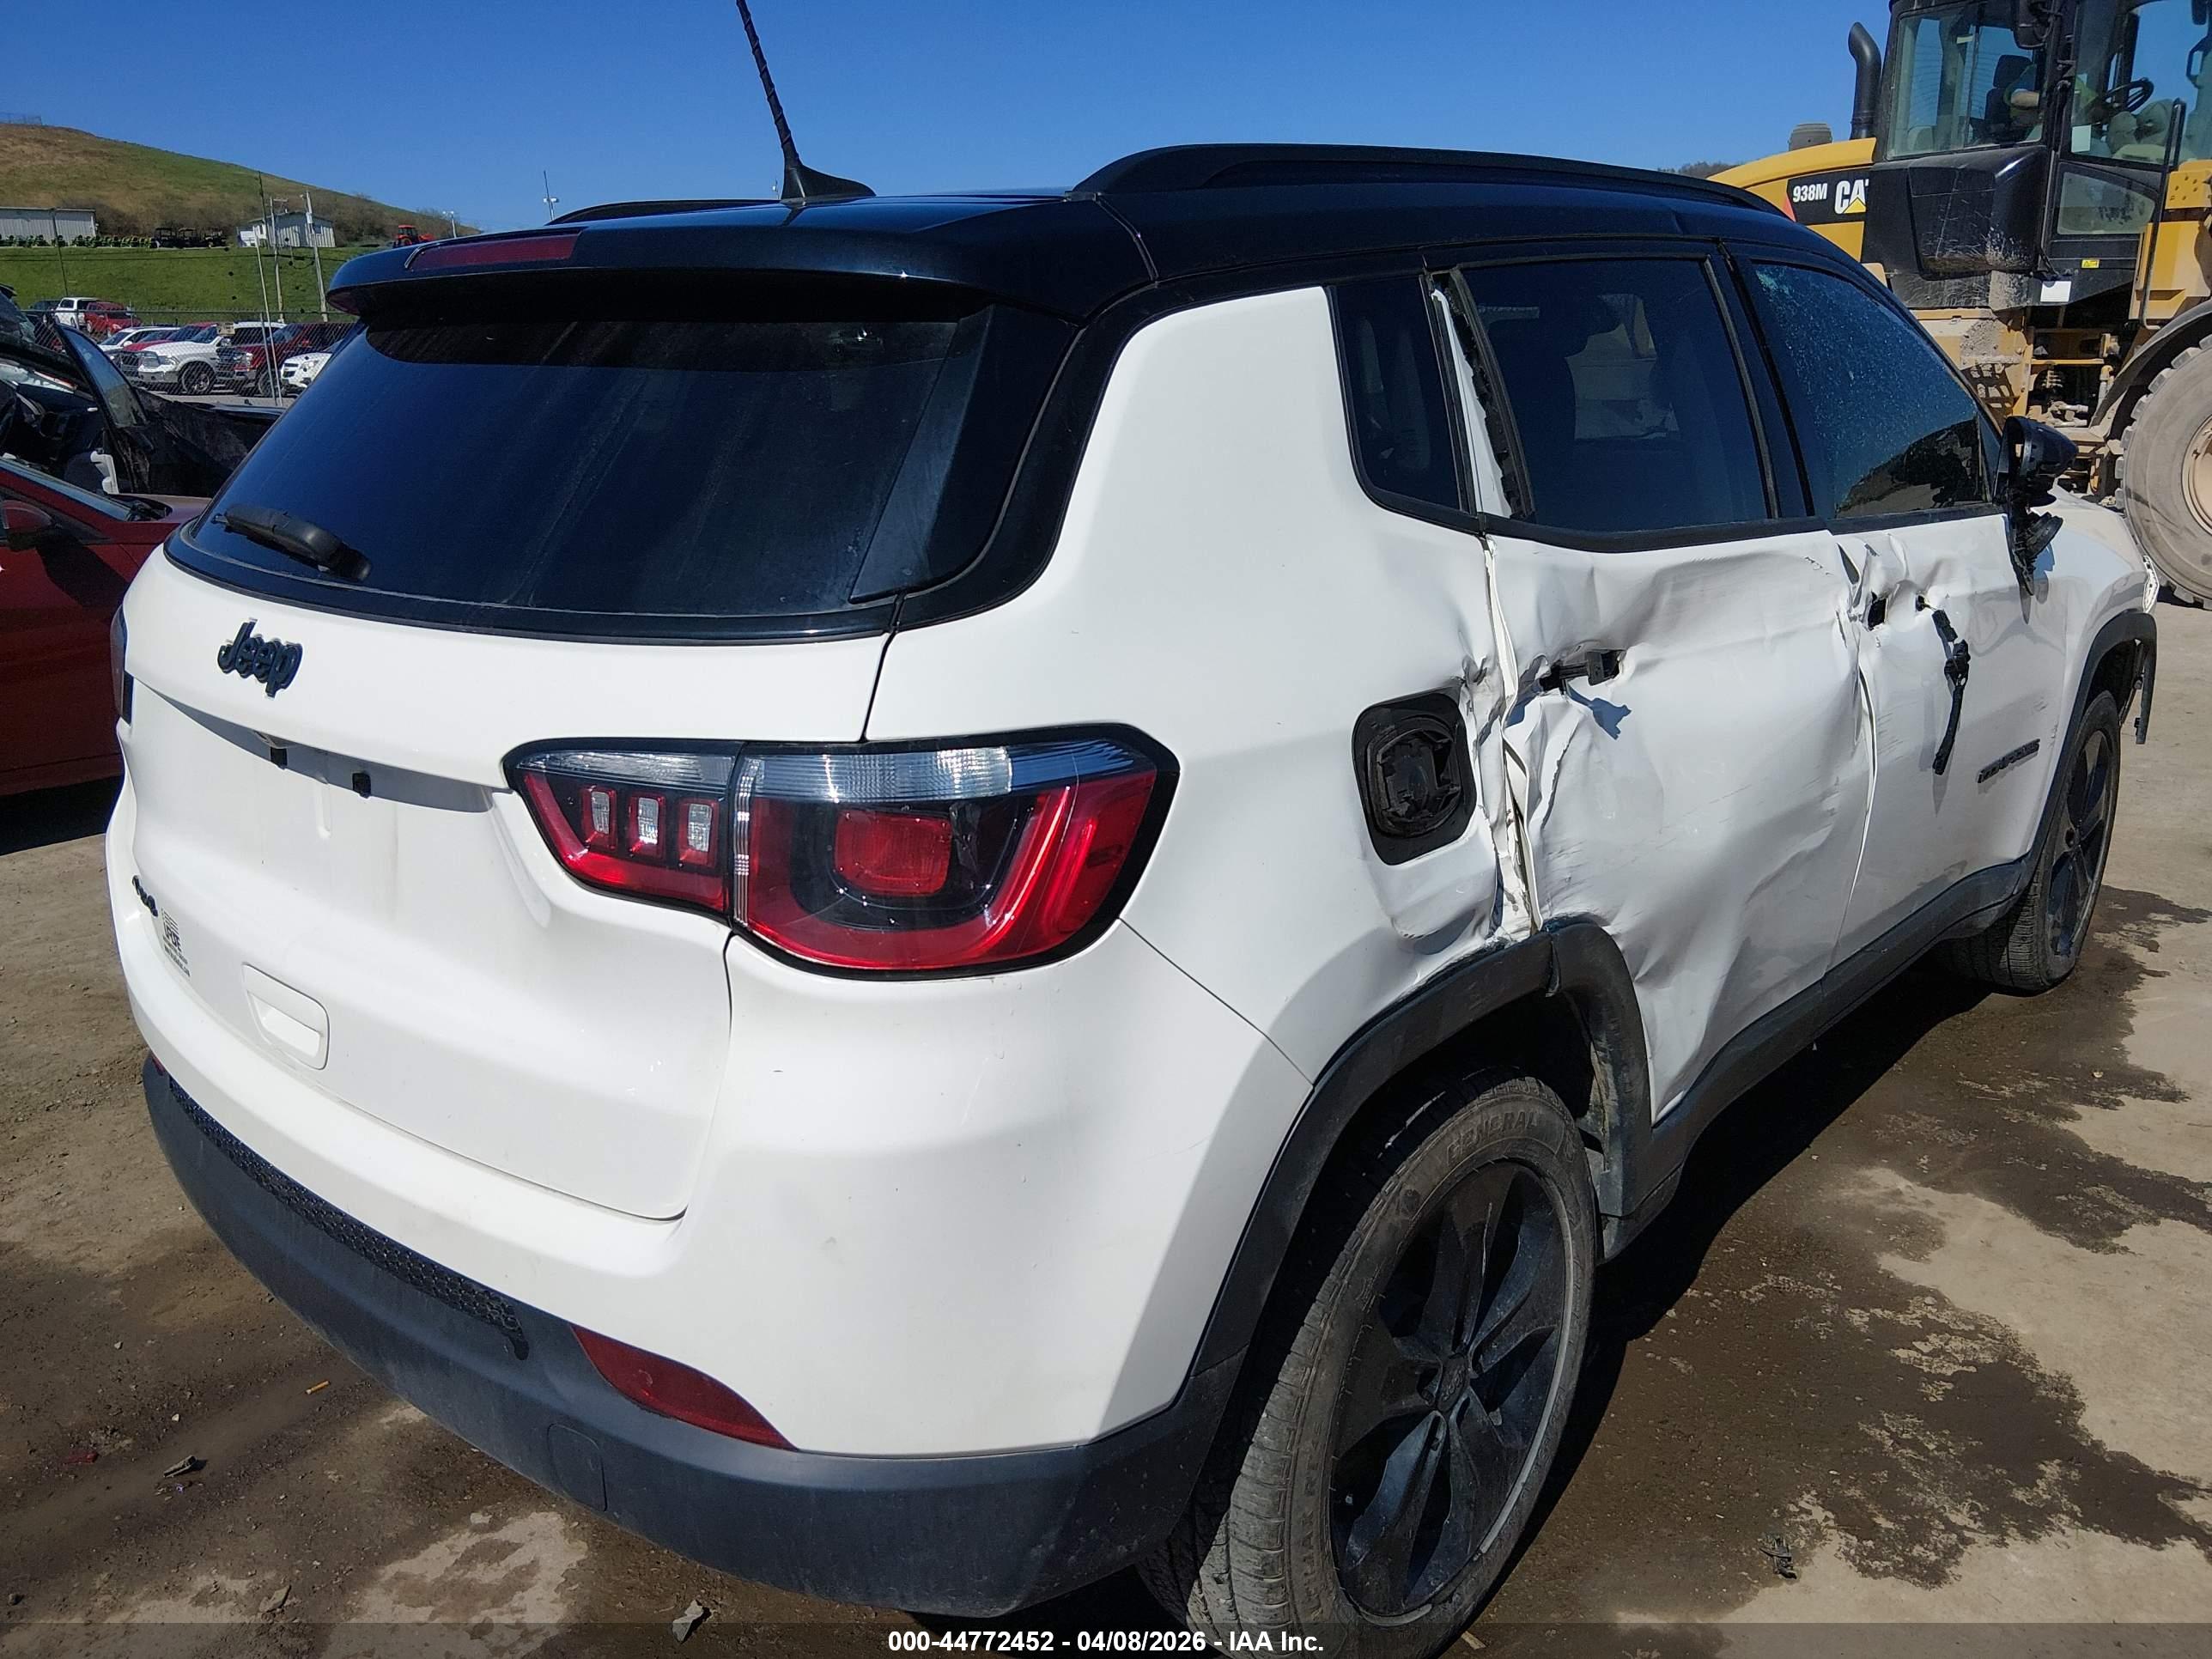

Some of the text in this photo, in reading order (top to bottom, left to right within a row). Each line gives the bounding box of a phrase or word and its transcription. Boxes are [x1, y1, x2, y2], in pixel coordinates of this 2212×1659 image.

[1792, 183, 1828, 203] 938M
[1834, 179, 1869, 215] CA
[217, 617, 303, 699] Jeep
